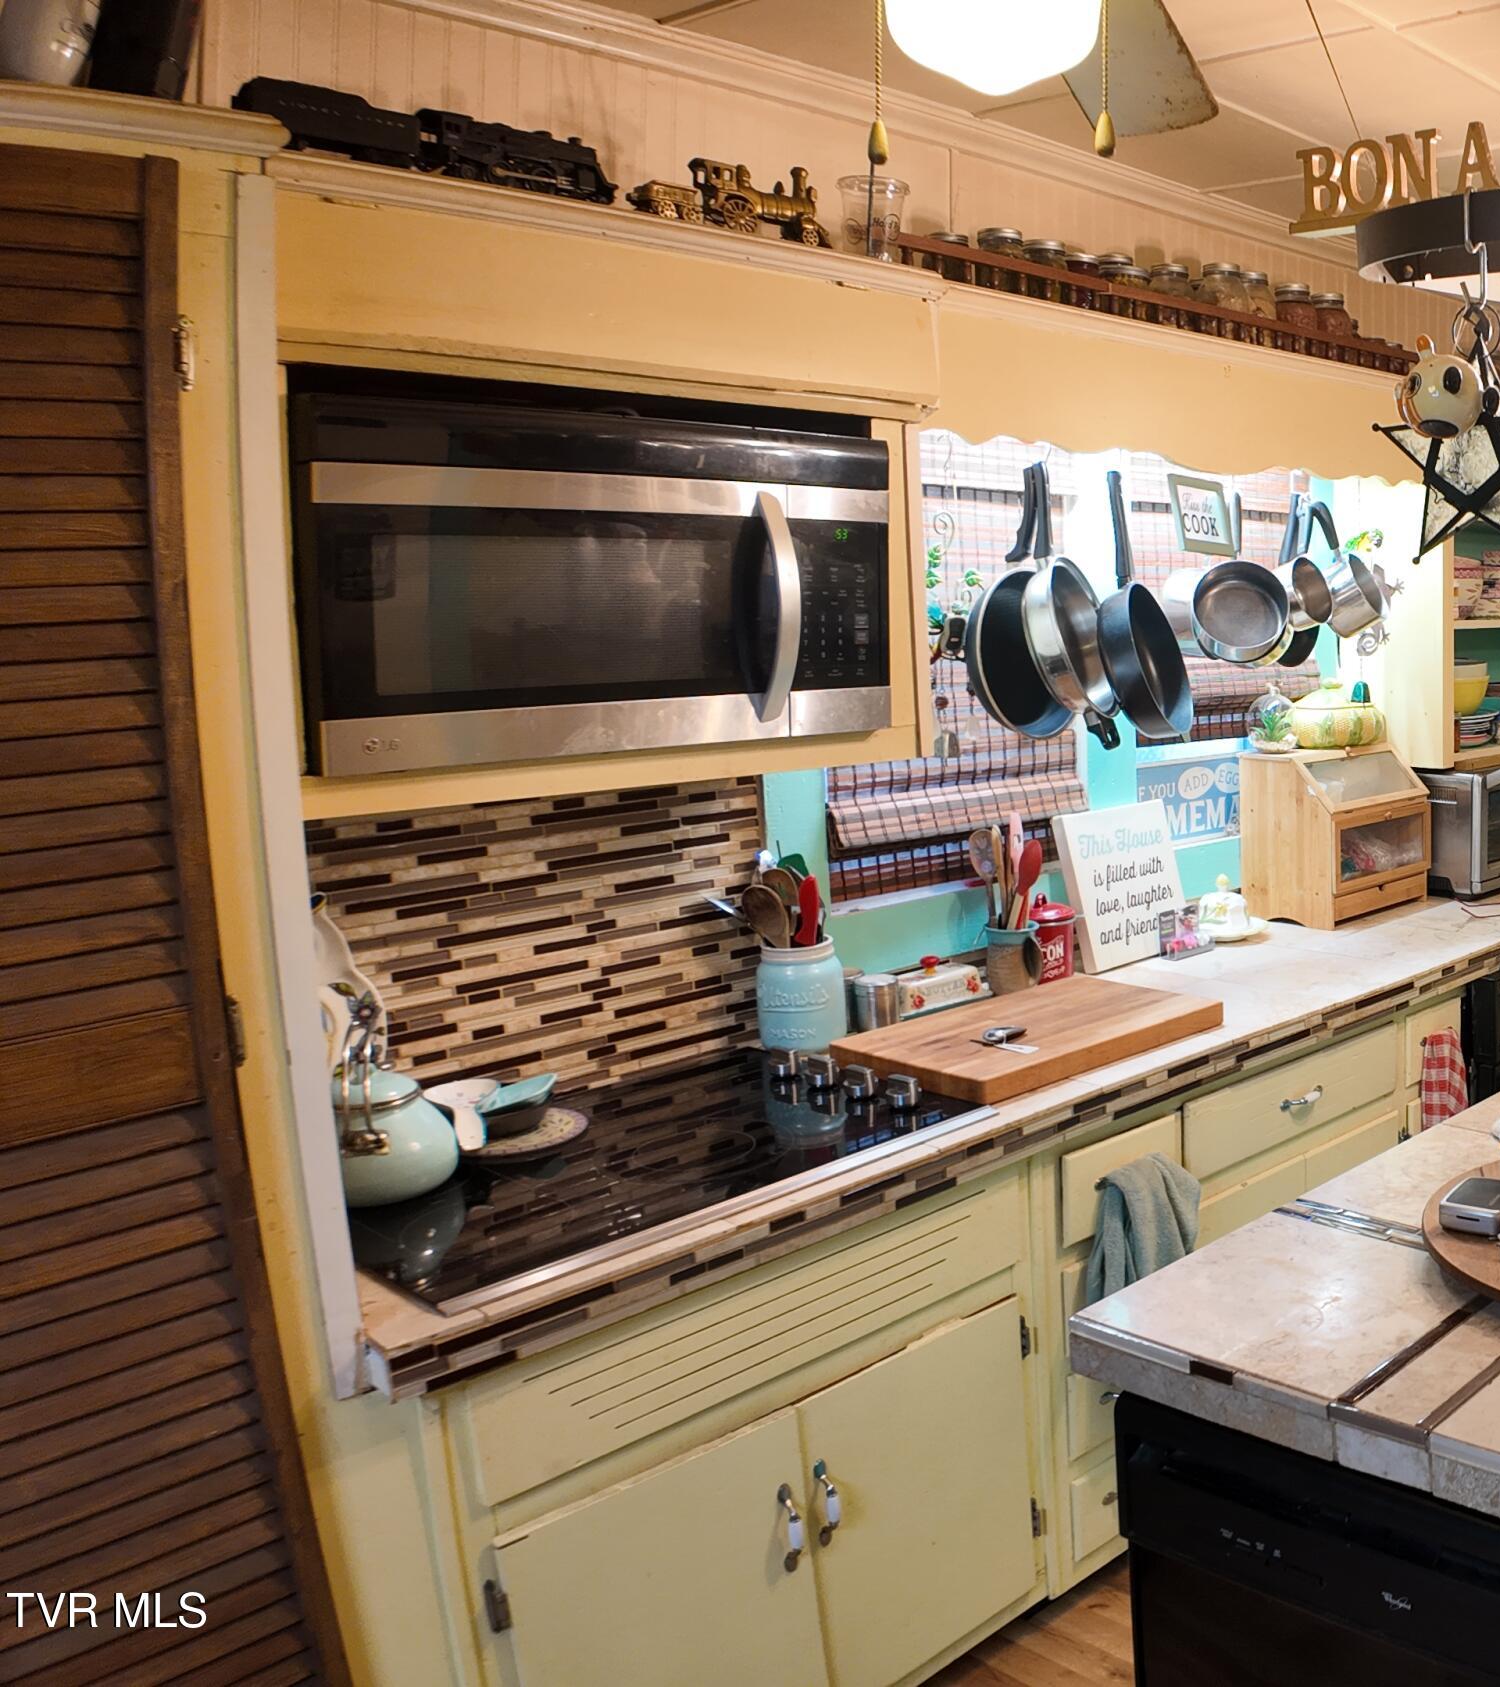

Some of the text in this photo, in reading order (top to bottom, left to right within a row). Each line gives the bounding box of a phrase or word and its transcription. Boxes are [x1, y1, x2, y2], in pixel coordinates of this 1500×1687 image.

[1296, 128, 1443, 221] BON
[1182, 513, 1219, 537] COOK
[1148, 782, 1176, 801] YOU
[1184, 772, 1209, 793] ADD
[1218, 769, 1240, 786] EGG
[1166, 795, 1240, 836] MEMA
[1078, 827, 1164, 860] This House
[1093, 855, 1165, 892] is filled with
[1095, 884, 1174, 917] love, laughter
[1100, 925, 1124, 946] and
[1125, 912, 1160, 946] friend
[769, 1027, 817, 1041] MASON
